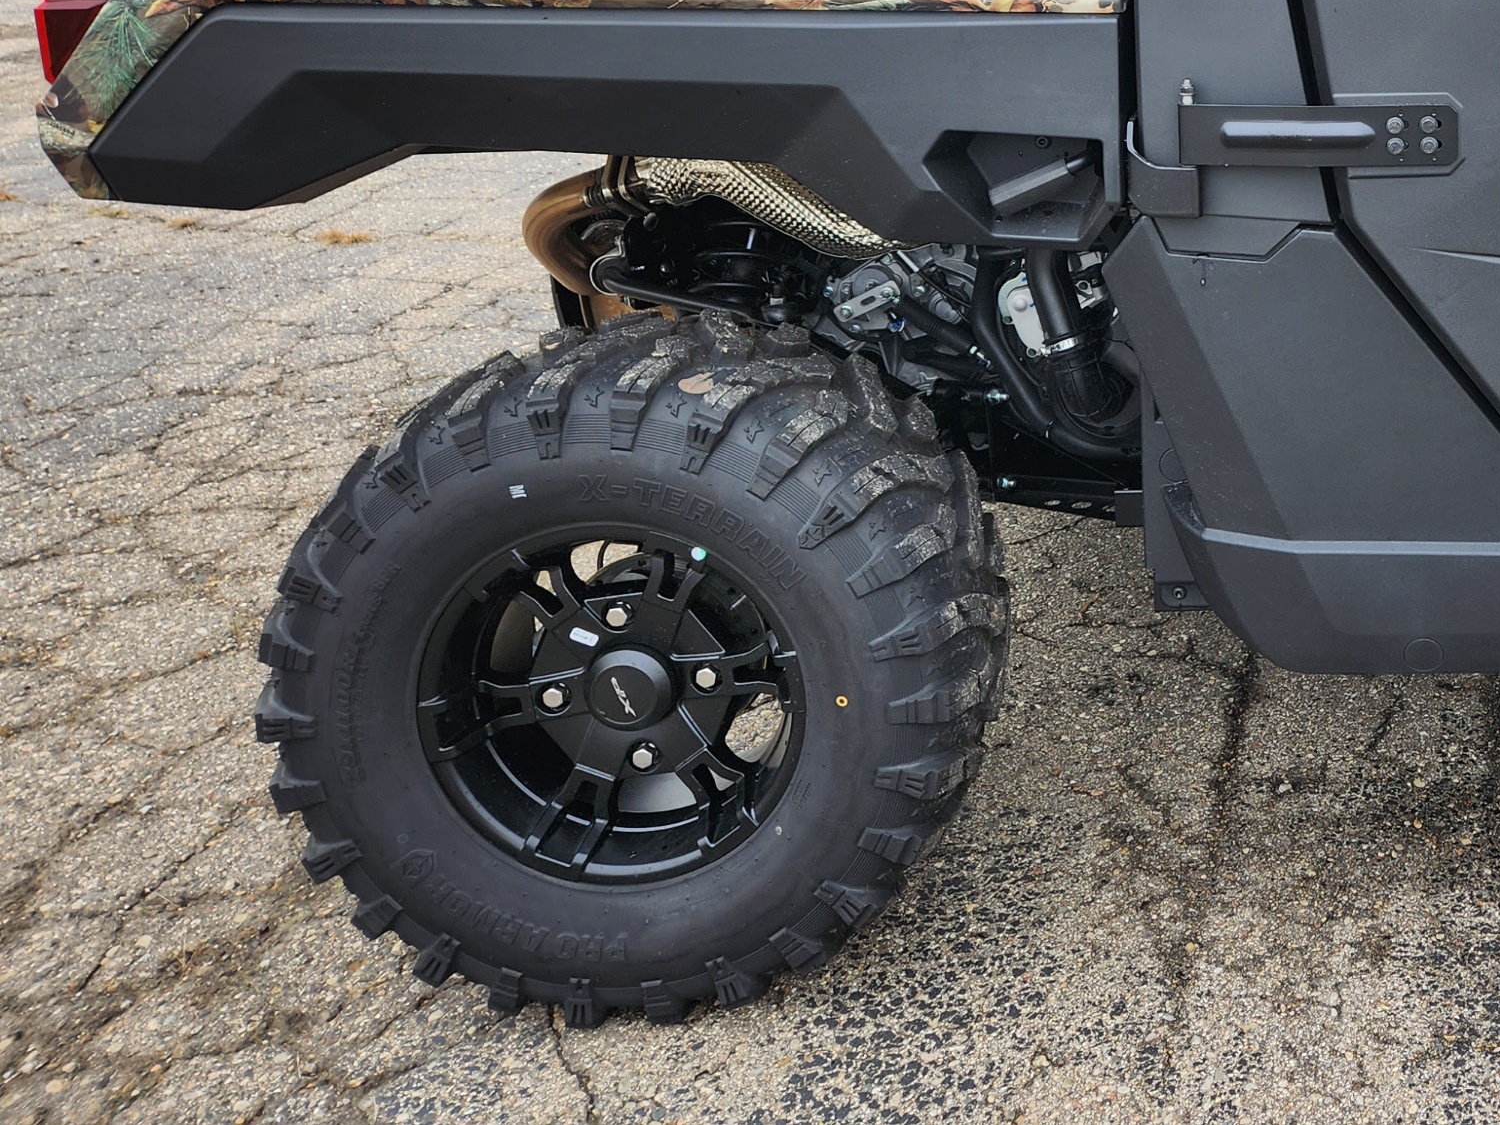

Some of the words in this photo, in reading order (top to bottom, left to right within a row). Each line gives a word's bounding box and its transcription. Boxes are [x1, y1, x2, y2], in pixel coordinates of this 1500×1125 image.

[578, 474, 806, 590] X-TERRAIN
[610, 677, 637, 717] XP
[425, 875, 550, 953] ARMOR
[556, 932, 628, 962] PRO
